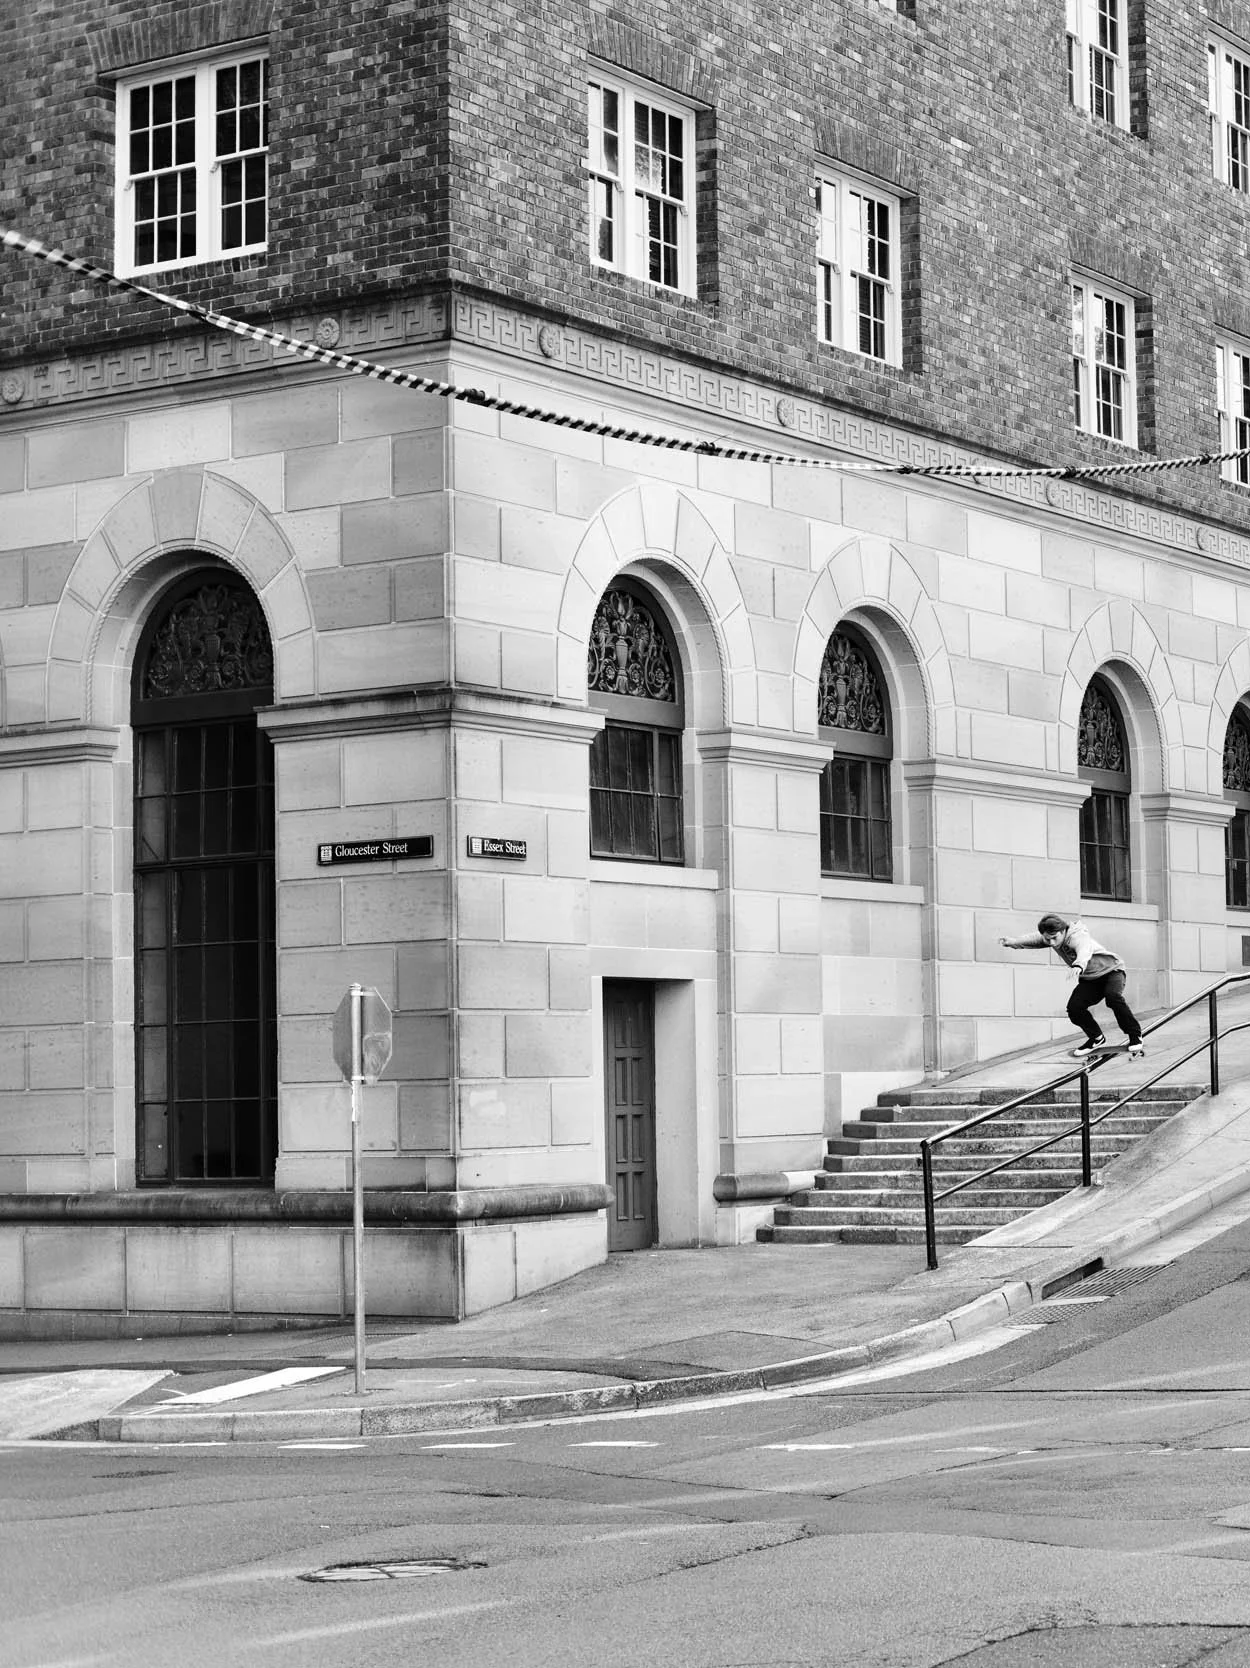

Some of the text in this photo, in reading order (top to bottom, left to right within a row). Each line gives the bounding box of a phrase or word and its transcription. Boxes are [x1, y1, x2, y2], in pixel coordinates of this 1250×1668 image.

[335, 842, 408, 857] Gloucester Street
[484, 840, 526, 855] Essex Street
